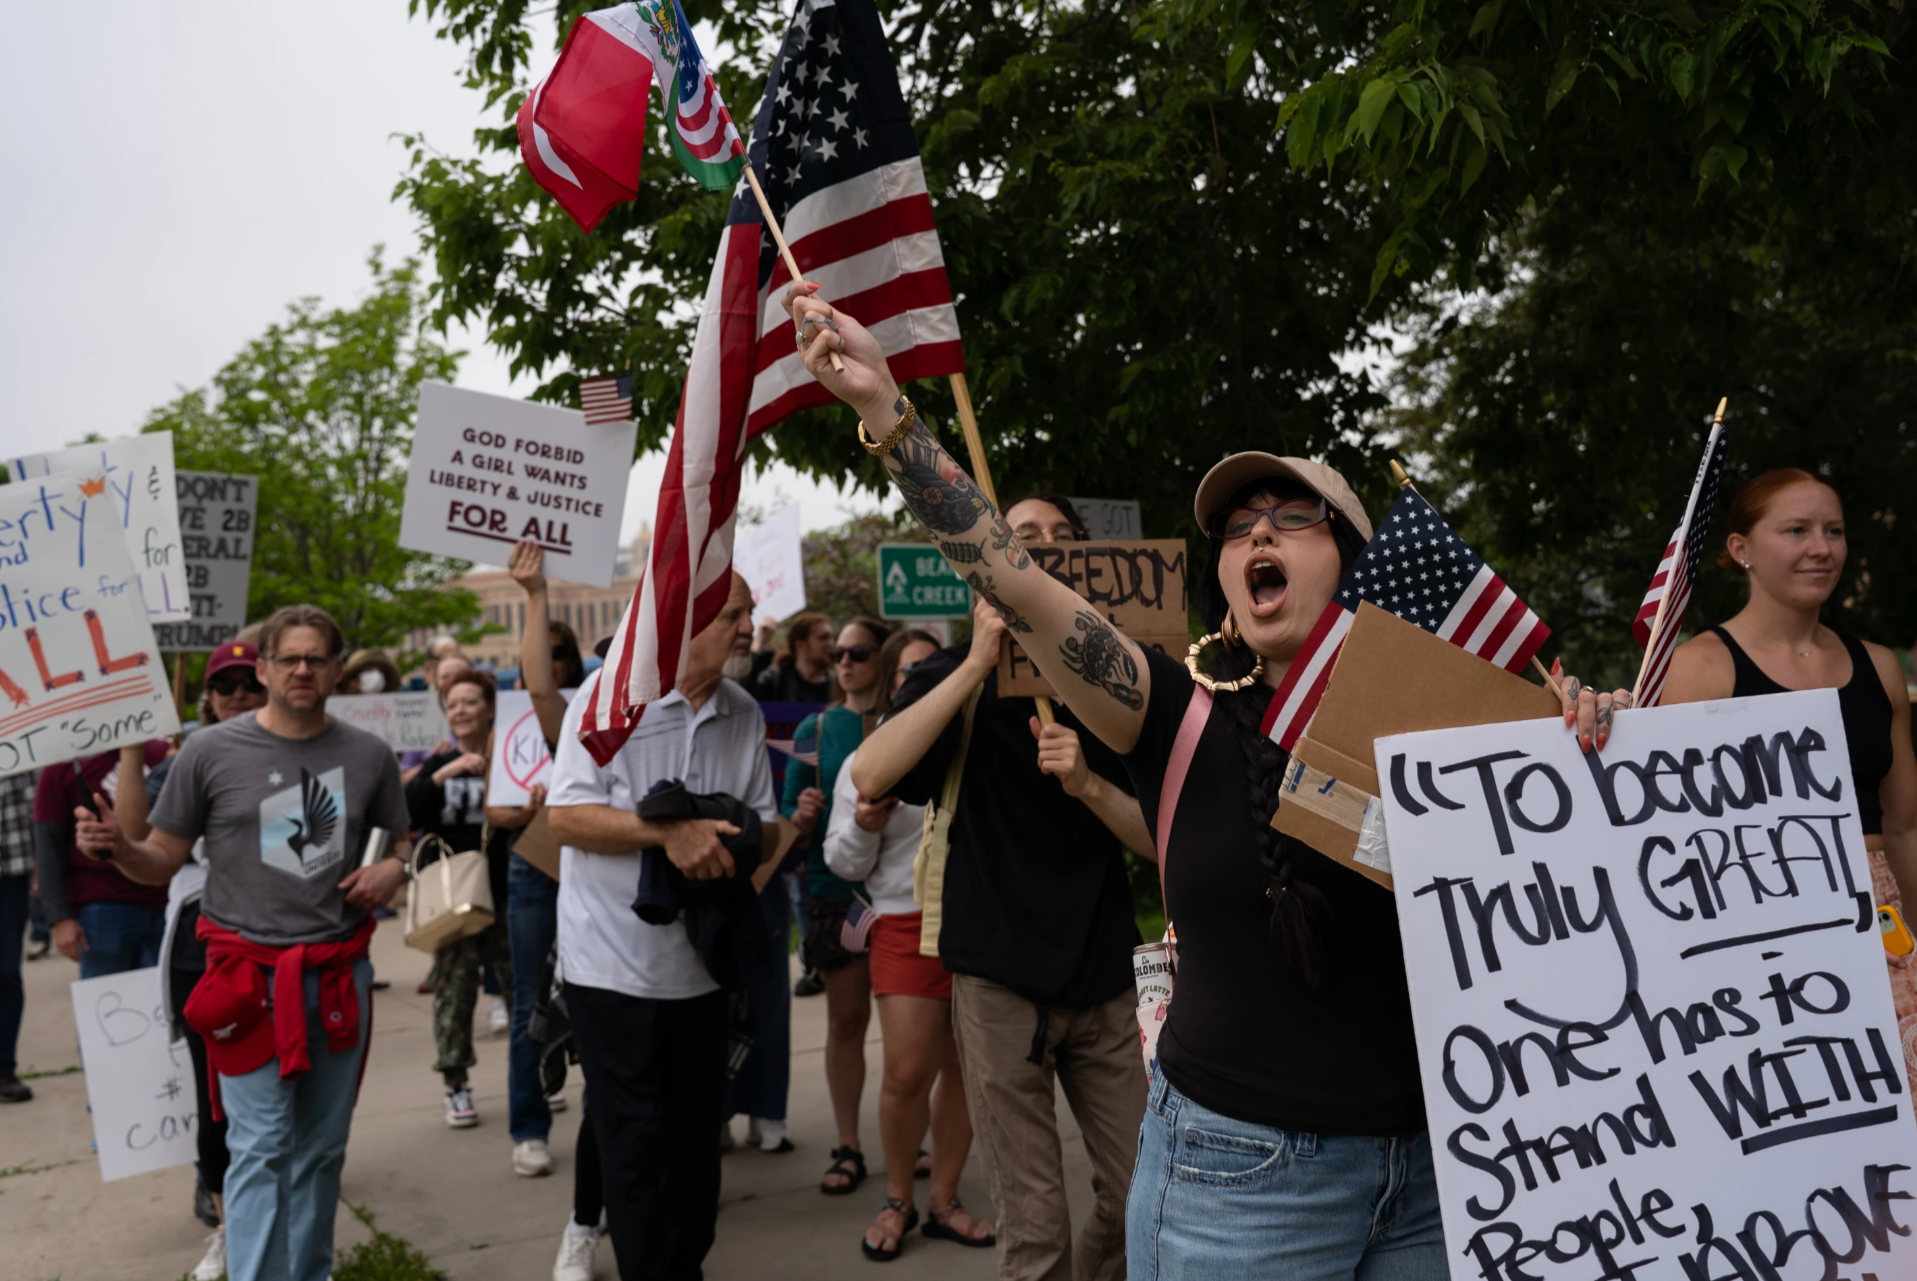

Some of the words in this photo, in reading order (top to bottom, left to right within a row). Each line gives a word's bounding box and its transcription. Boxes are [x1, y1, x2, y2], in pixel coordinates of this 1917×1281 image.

[462, 428, 507, 449] GOD
[513, 438, 585, 464] FORBID
[450, 449, 464, 465] A
[471, 454, 514, 476] GIRL
[524, 463, 588, 490] WANTS
[429, 469, 502, 497] LIBERTY
[506, 485, 520, 501] &
[527, 491, 604, 518] JUSTICE
[222, 508, 250, 532] 2B
[449, 500, 508, 533] FOR
[521, 516, 572, 547] ALL
[1100, 502, 1134, 535] GOT
[915, 556, 955, 577] BEA
[97, 574, 128, 599] for
[912, 585, 967, 606] CREEK
[1575, 726, 1842, 827] become
[1413, 861, 1639, 1031] Truly
[1149, 985, 1170, 997] LATTE
[1442, 1021, 1621, 1114] One
[1625, 987, 1761, 1065] has
[1759, 971, 1851, 1026] to
[1688, 1028, 1902, 1140] WITH
